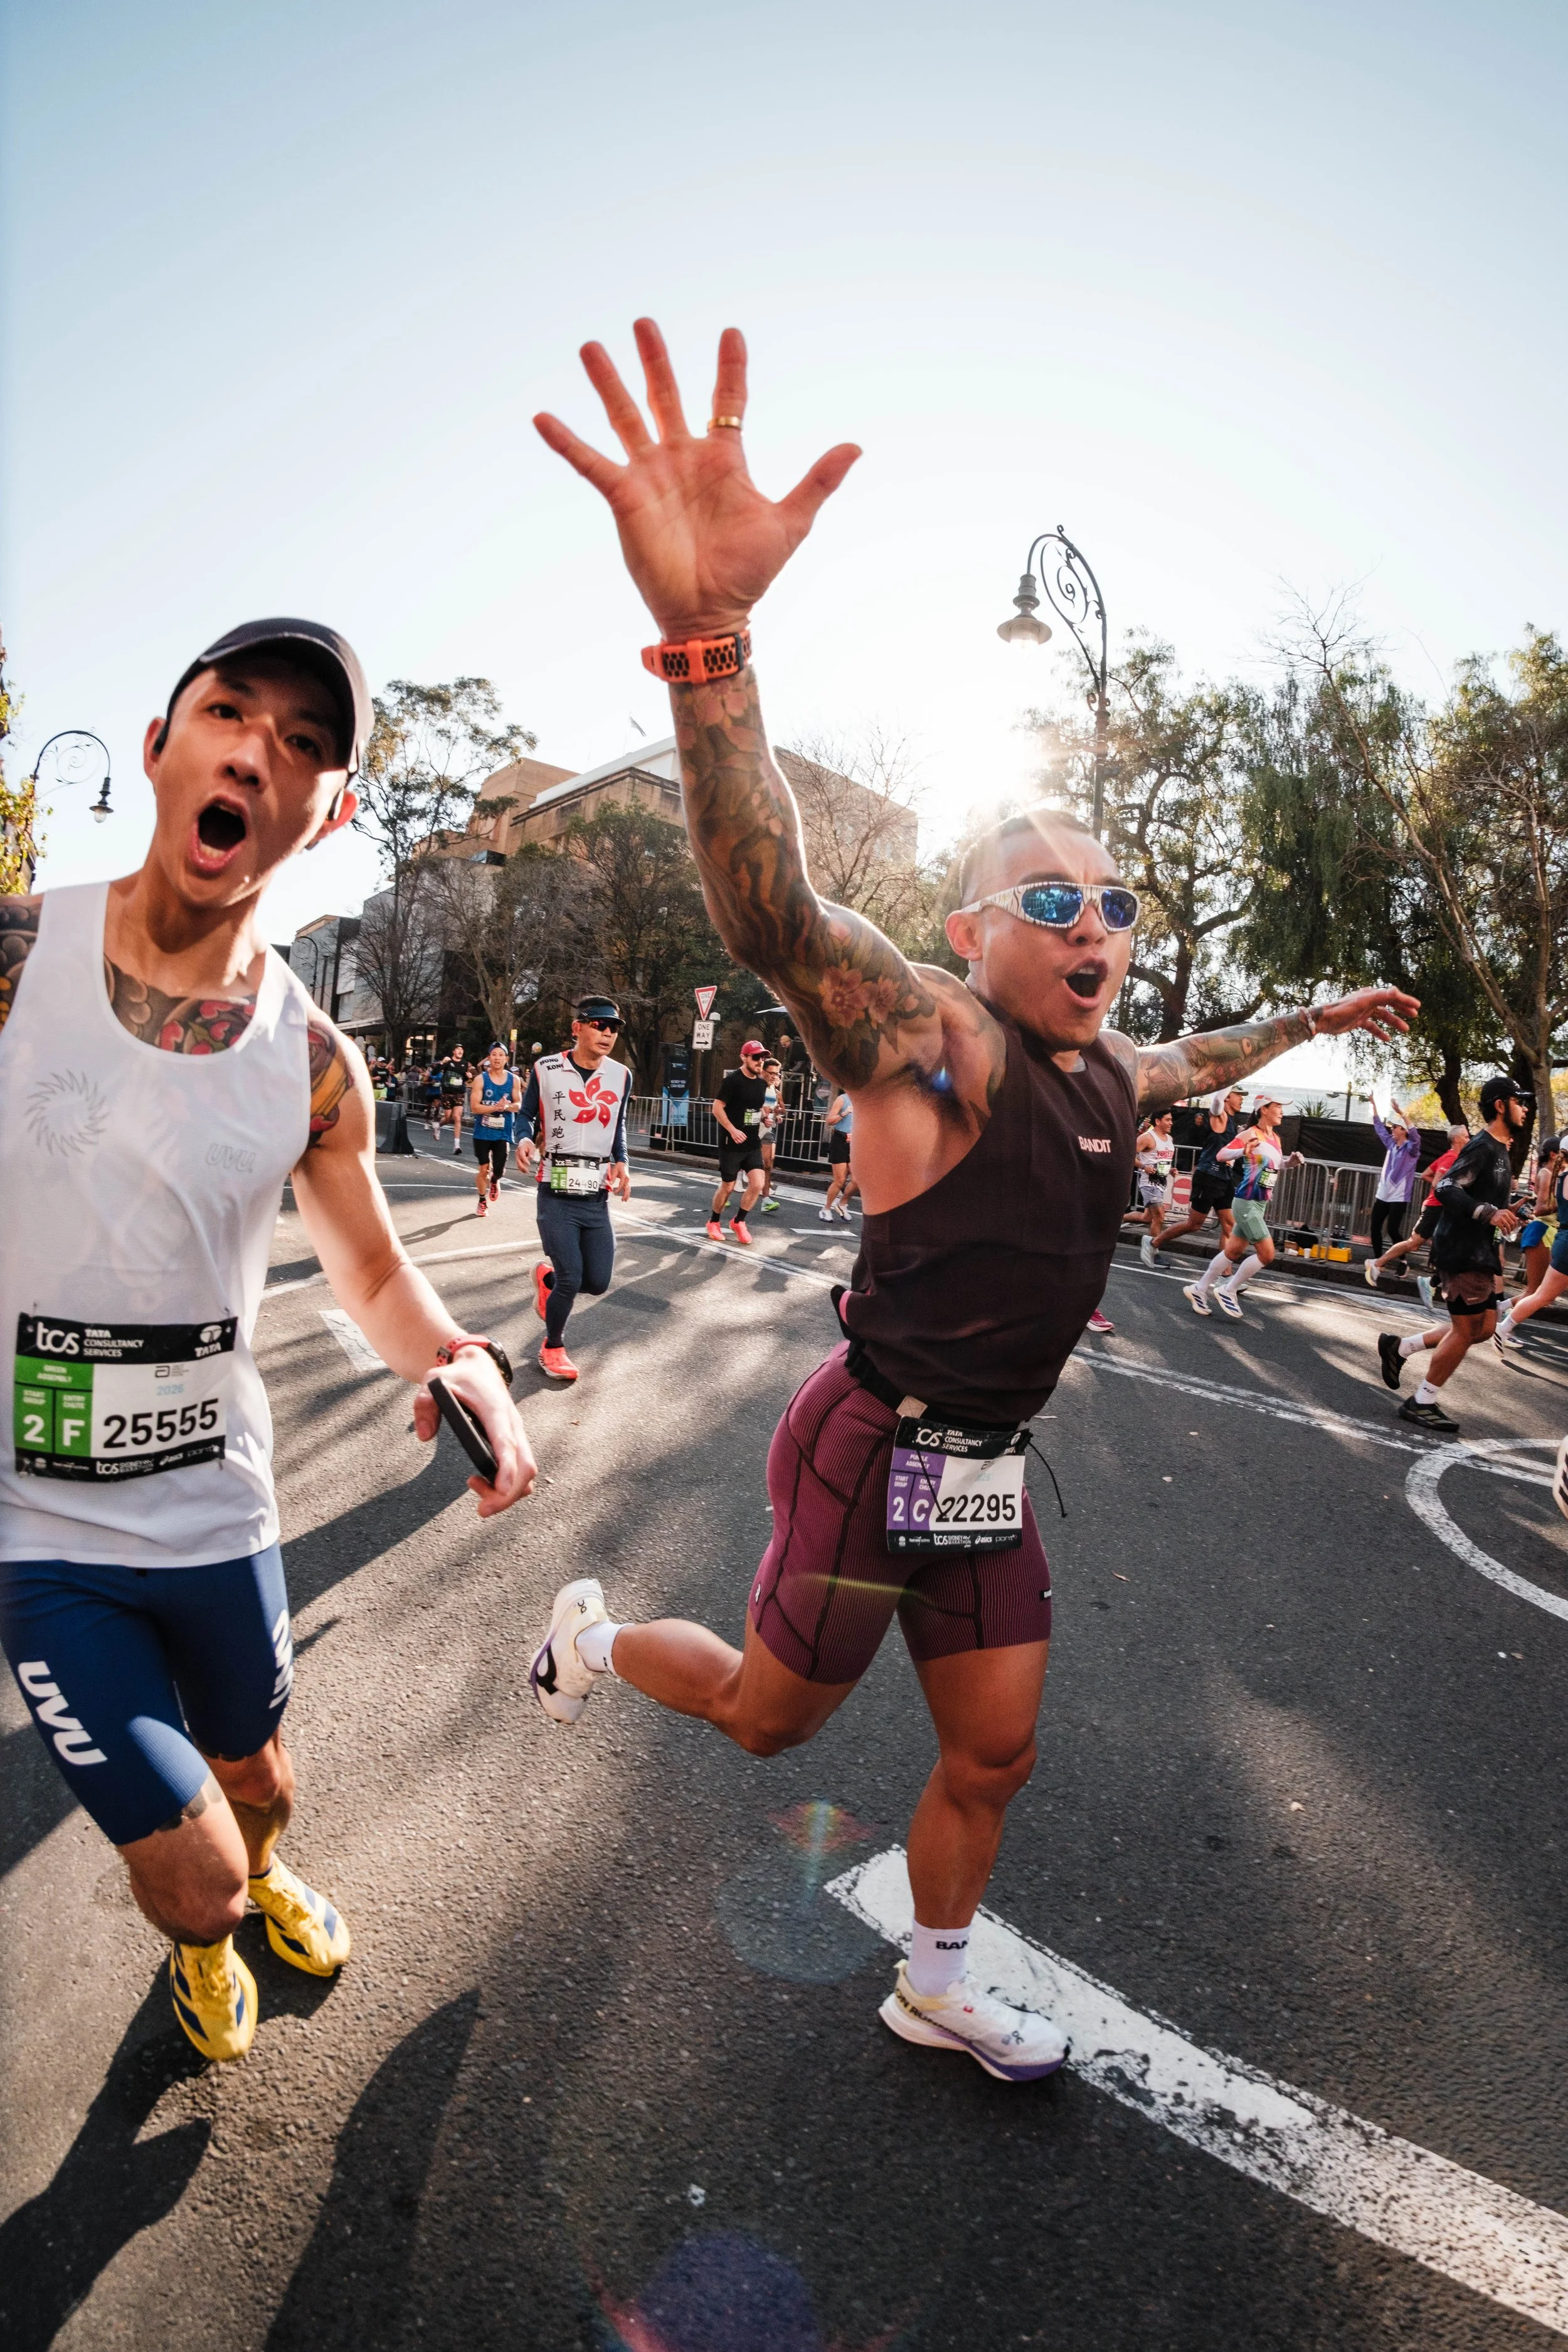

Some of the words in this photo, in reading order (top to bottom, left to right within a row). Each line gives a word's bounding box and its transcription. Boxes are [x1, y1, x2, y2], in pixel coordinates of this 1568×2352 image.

[551, 1091, 566, 1153] 平民跑手
[1078, 1136, 1111, 1153] BANDIT
[37, 1322, 80, 1355] tcs
[83, 1339, 144, 1348] CONSULTANCY
[85, 1329, 112, 1338] TATA
[83, 1348, 122, 1357] SERVICES
[194, 1342, 221, 1357] TATA
[24, 1414, 45, 1443] 2
[63, 1419, 85, 1446] F
[103, 1398, 218, 1449] 25555
[913, 1428, 943, 1447] cs
[941, 1443, 968, 1453] SERVICES
[945, 1436, 983, 1446] CONSULTANCY
[893, 1496, 904, 1521] 2
[913, 1499, 930, 1522] C
[935, 1494, 1016, 1522] 22295
[933, 1533, 948, 1545] tcs
[18, 1661, 108, 1766] UVU
